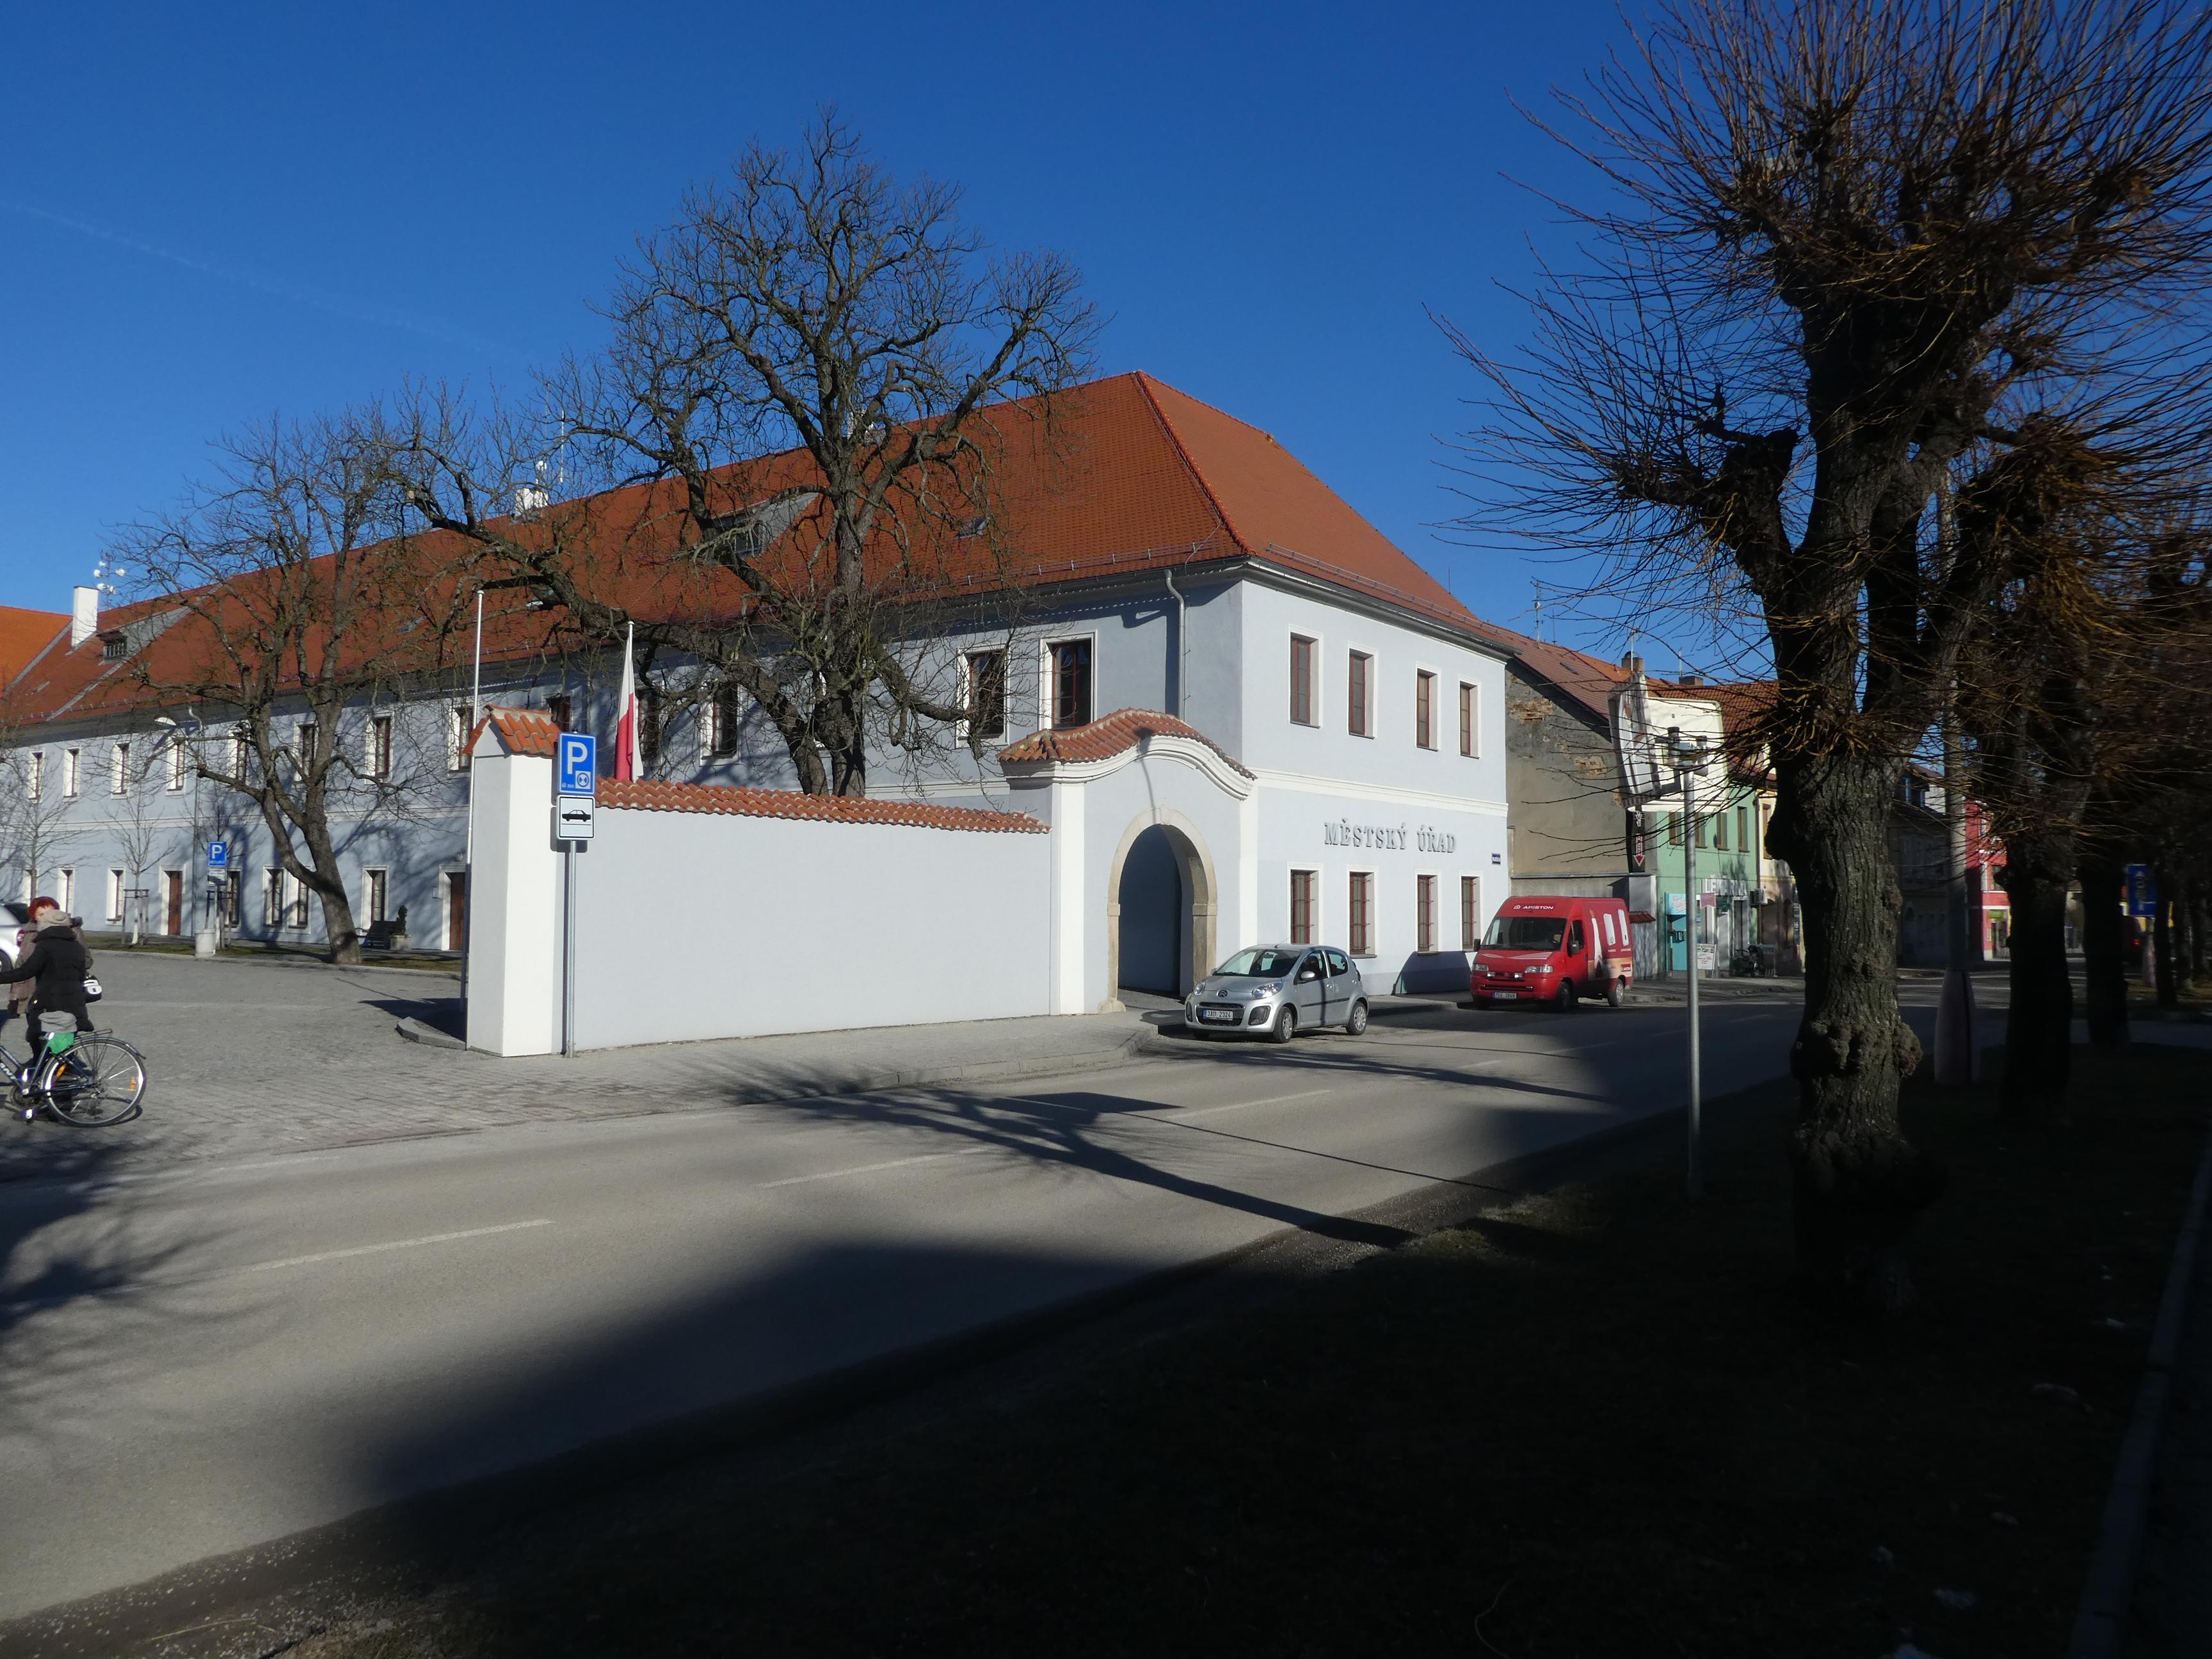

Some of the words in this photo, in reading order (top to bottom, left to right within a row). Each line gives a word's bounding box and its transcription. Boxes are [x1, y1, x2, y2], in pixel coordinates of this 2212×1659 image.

[567, 741, 588, 774] P
[212, 845, 223, 859] P
[1324, 818, 1408, 849] MĚSTSKÝ
[1416, 824, 1456, 853] ÚŘAD
